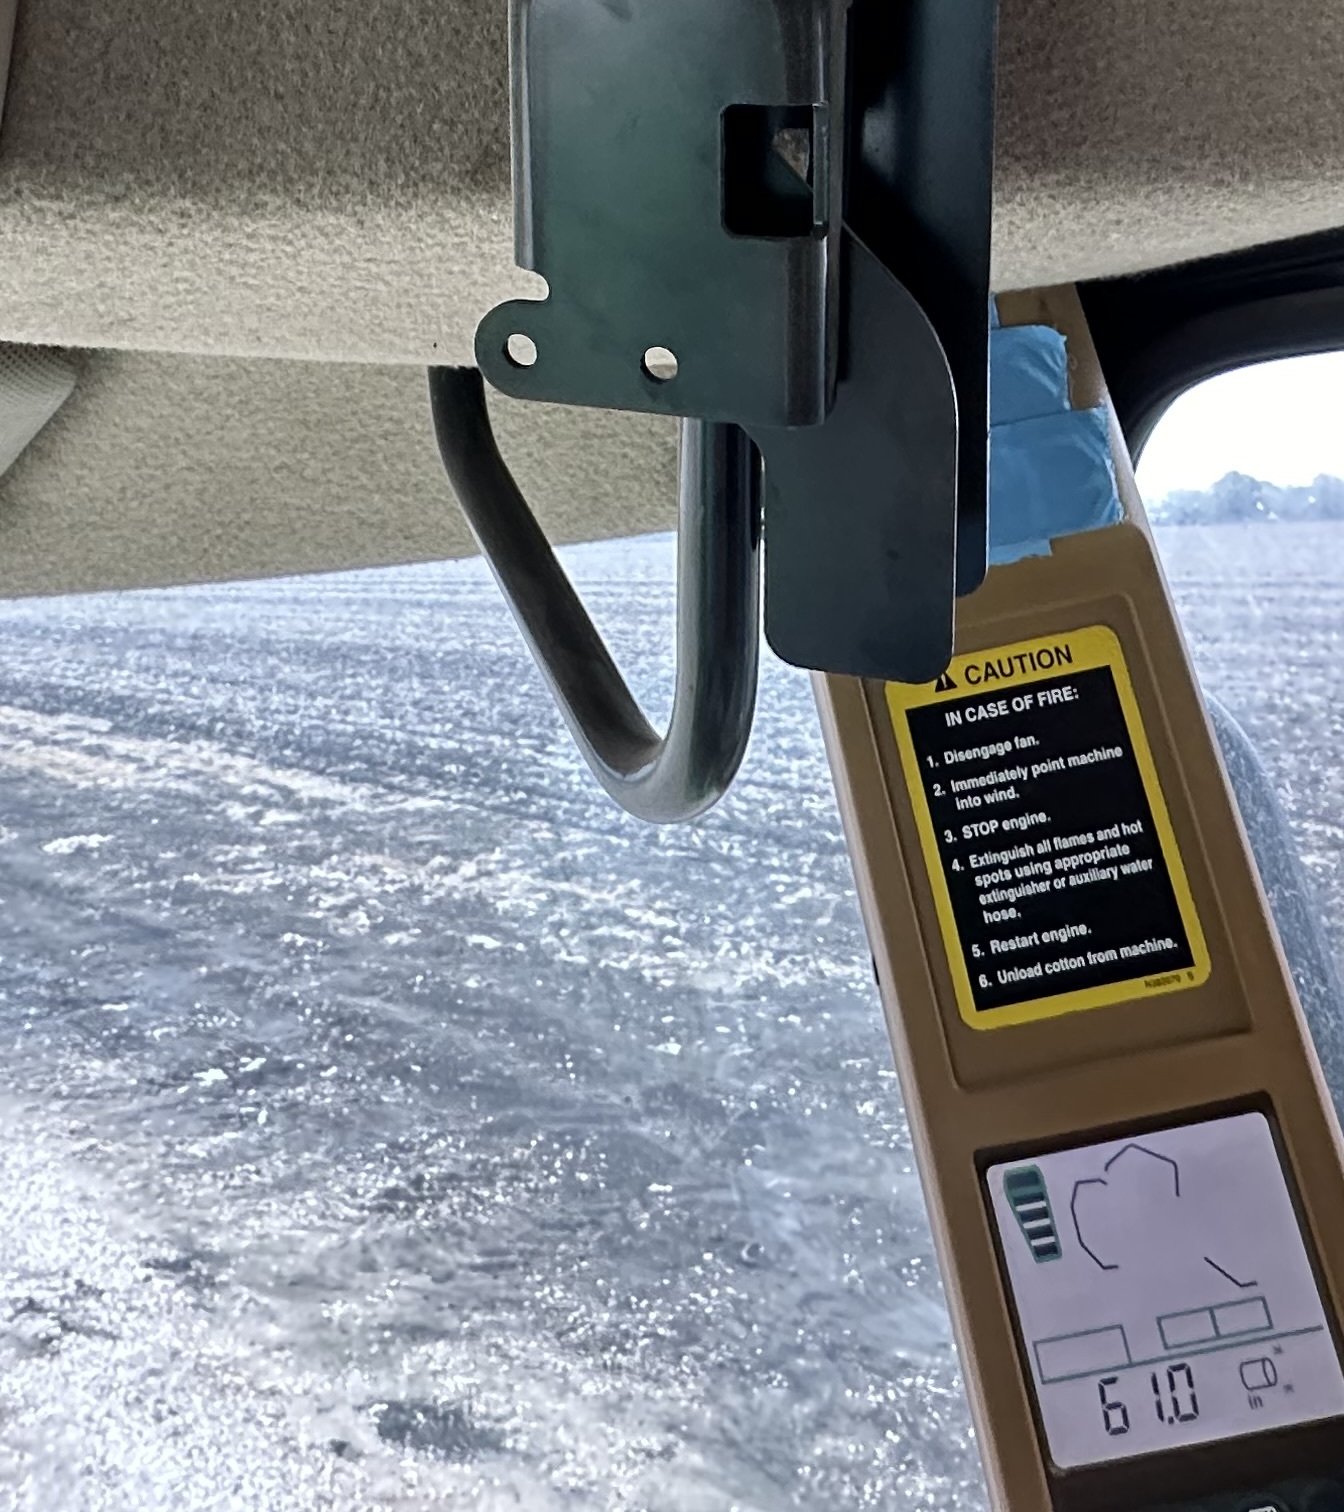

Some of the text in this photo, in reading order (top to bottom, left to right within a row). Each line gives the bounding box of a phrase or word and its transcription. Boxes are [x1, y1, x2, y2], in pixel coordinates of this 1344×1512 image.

[964, 643, 1074, 686] CAUTION
[944, 685, 1079, 727] IN CASE OF FIRE:
[926, 735, 1040, 768] 1. Disengage fan.
[932, 746, 1123, 797] 2. Immediately point machine
[954, 785, 1020, 811] into wind.
[943, 811, 1051, 844] 3. STOP engine.
[951, 819, 1144, 872] 4. Extinguish all flames and hot
[974, 843, 1131, 889] spots using appropriate
[978, 858, 1153, 906] extinguisher or auxiliary water
[982, 907, 1022, 924] hose.
[971, 923, 1092, 958] 5. Restart engine.
[978, 937, 1178, 988] 6. Unload cotton from machine.
[1098, 1363, 1200, 1437] 61.0
